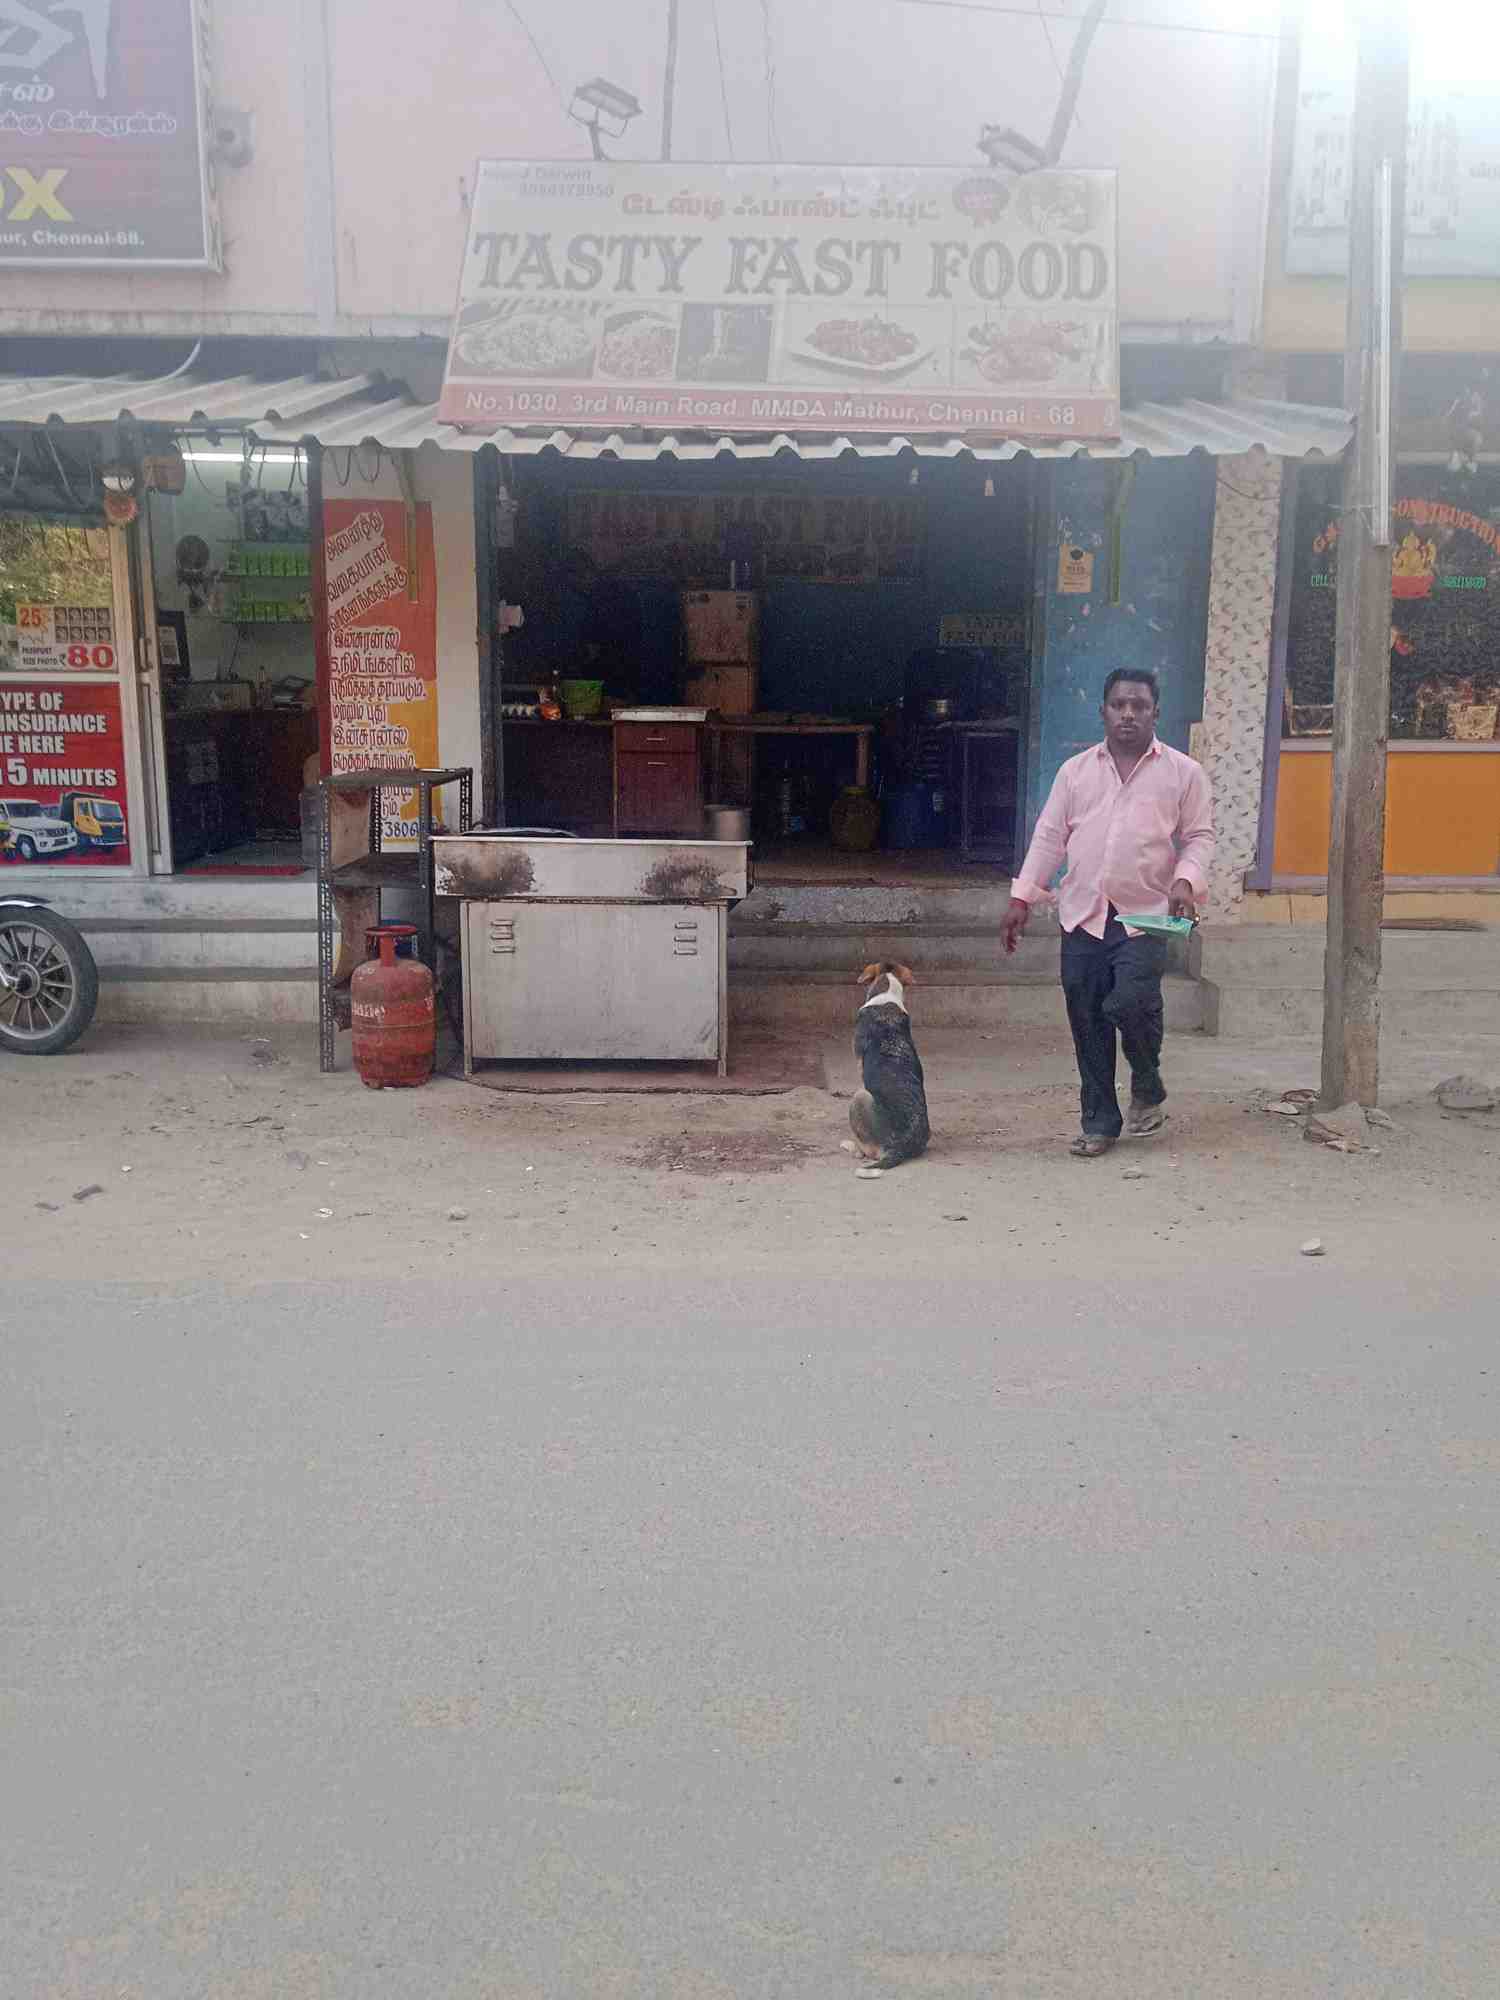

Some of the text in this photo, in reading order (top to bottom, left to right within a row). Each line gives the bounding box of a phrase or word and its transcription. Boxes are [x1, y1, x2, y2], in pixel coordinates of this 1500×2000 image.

[0, 166, 73, 223] X
[474, 233, 1108, 300] TASTY FAST FOOD
[571, 395, 608, 413] 3rd
[615, 395, 670, 415] Main
[751, 399, 826, 418] MMDA
[927, 403, 1025, 423] Chennai
[39, 691, 63, 711] OF
[18, 735, 64, 753] HERE
[7, 758, 117, 787] 5 MINUTES
